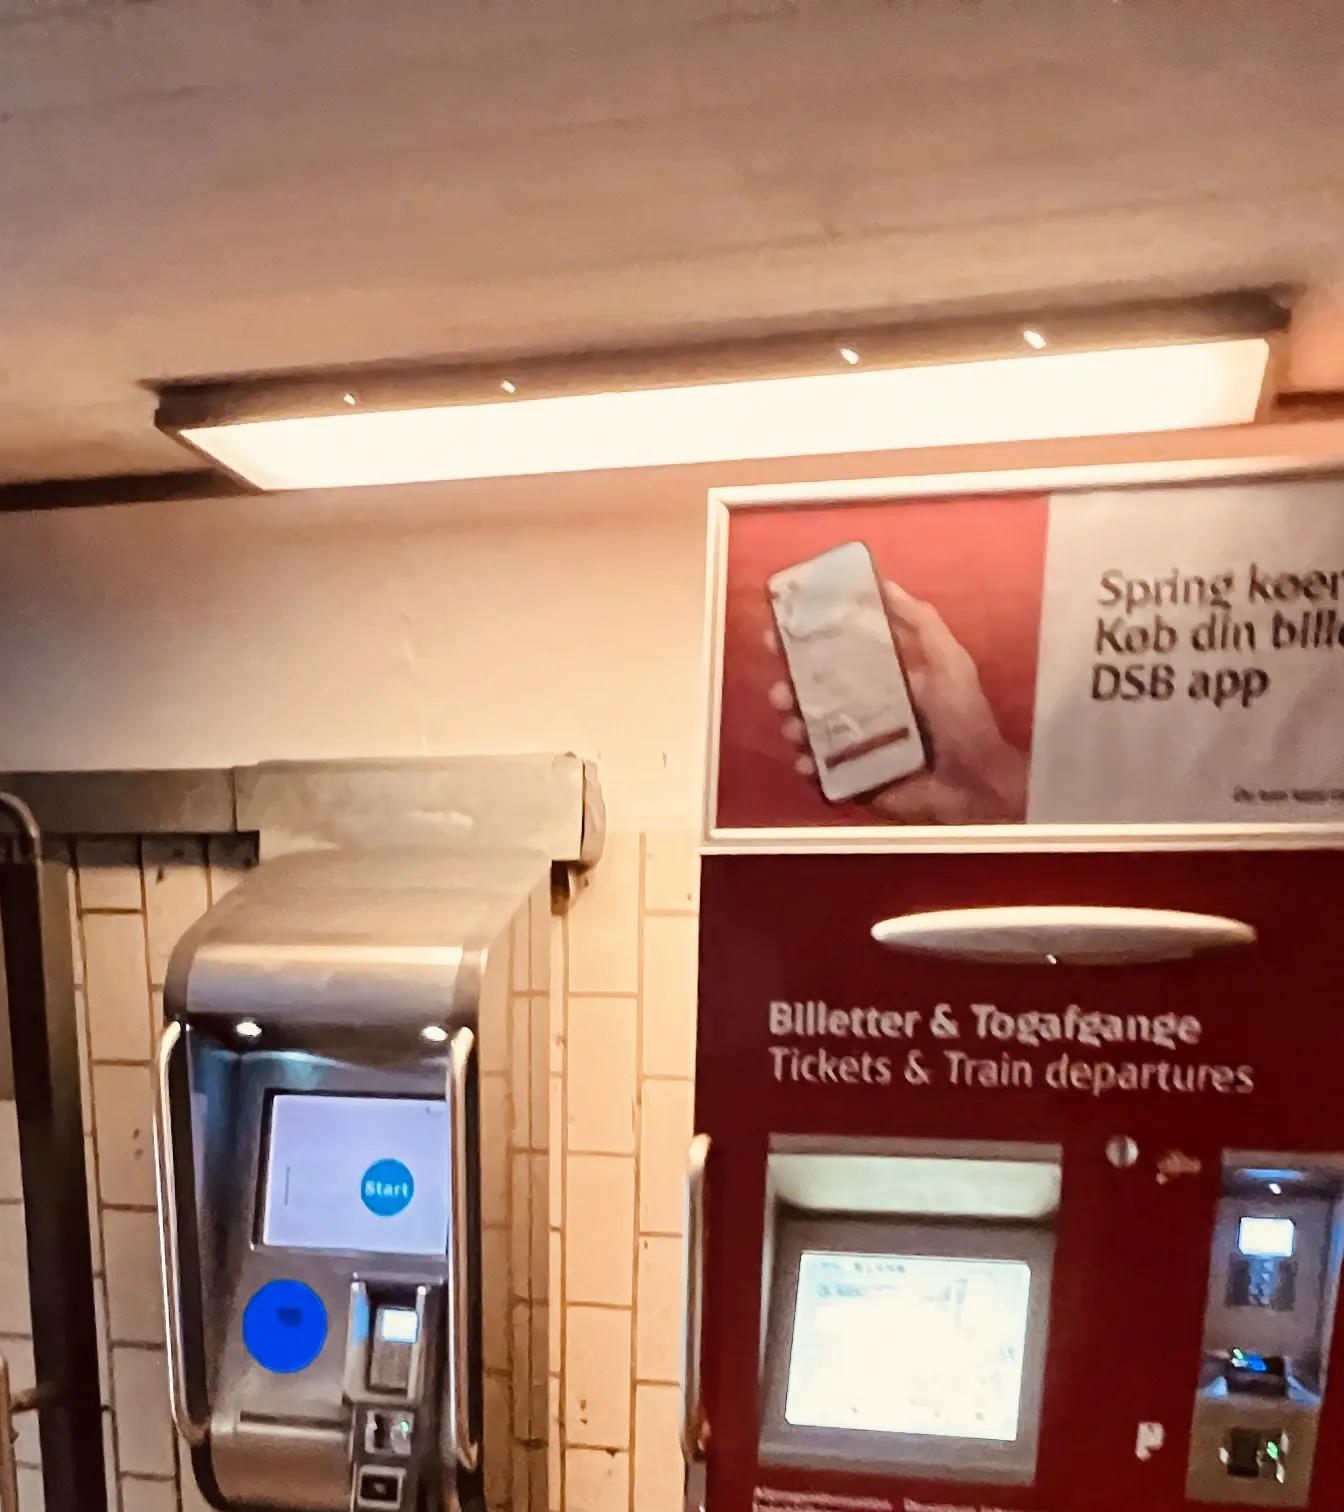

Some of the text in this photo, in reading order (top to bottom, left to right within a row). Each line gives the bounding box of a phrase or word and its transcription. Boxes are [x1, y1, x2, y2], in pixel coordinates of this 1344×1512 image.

[1097, 566, 1234, 615] Spring
[1191, 610, 1256, 652] din
[1091, 662, 1271, 708] DSB app
[769, 1000, 1203, 1051] Billetter & Togafgange
[767, 1046, 1255, 1097] Tickets & Train departures
[365, 1179, 409, 1198] Start
